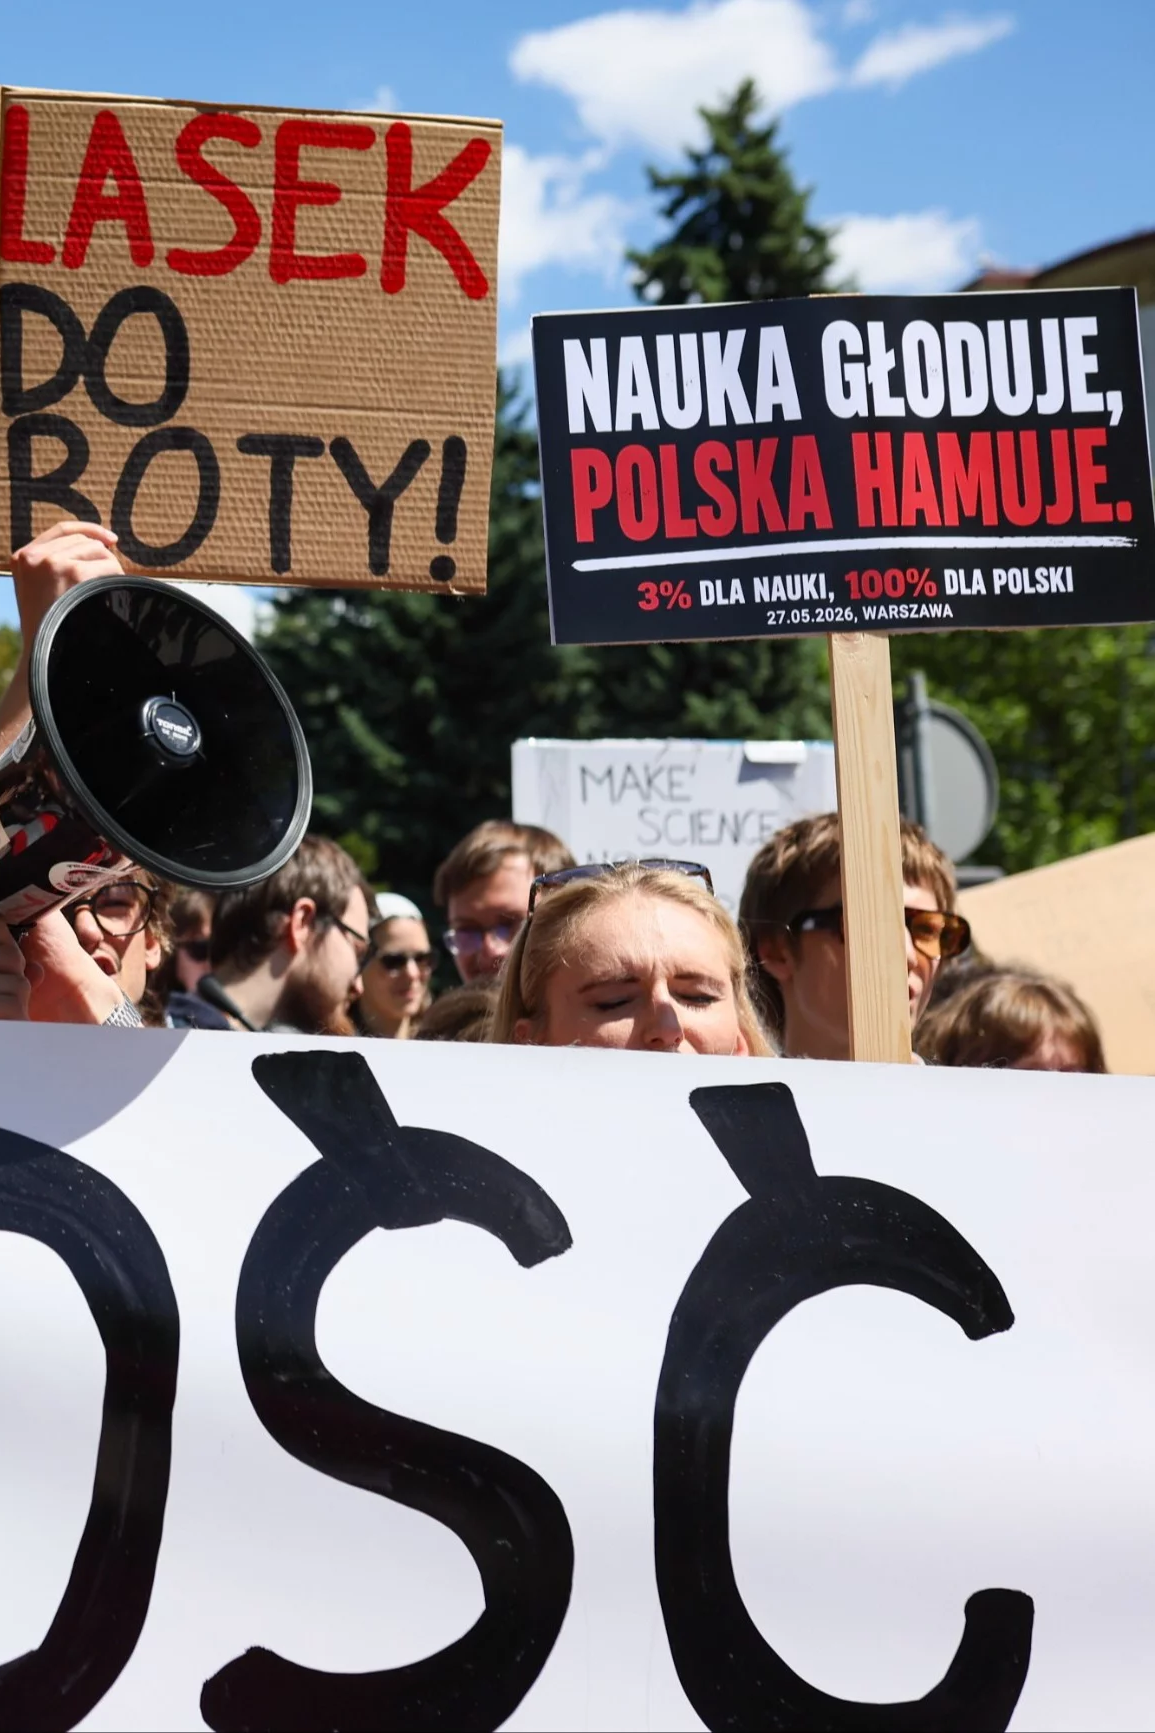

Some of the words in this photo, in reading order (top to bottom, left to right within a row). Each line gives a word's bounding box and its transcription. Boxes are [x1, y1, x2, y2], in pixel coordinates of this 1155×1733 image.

[563, 325, 802, 434] NAUKA
[821, 316, 1124, 426] GŁODUJE,
[571, 435, 834, 543] POLSKA
[852, 427, 1134, 527] HAMUJE.
[637, 579, 693, 611] 3%
[699, 579, 746, 607] DLA
[753, 573, 835, 605] NAUKI,
[844, 568, 938, 600] 100%
[944, 567, 985, 596] DLA
[993, 565, 1075, 595] POLSKI
[767, 608, 859, 625] 27.05.2026,
[863, 603, 954, 621] WARSZAWA
[637, 807, 779, 847] SCIENCE
